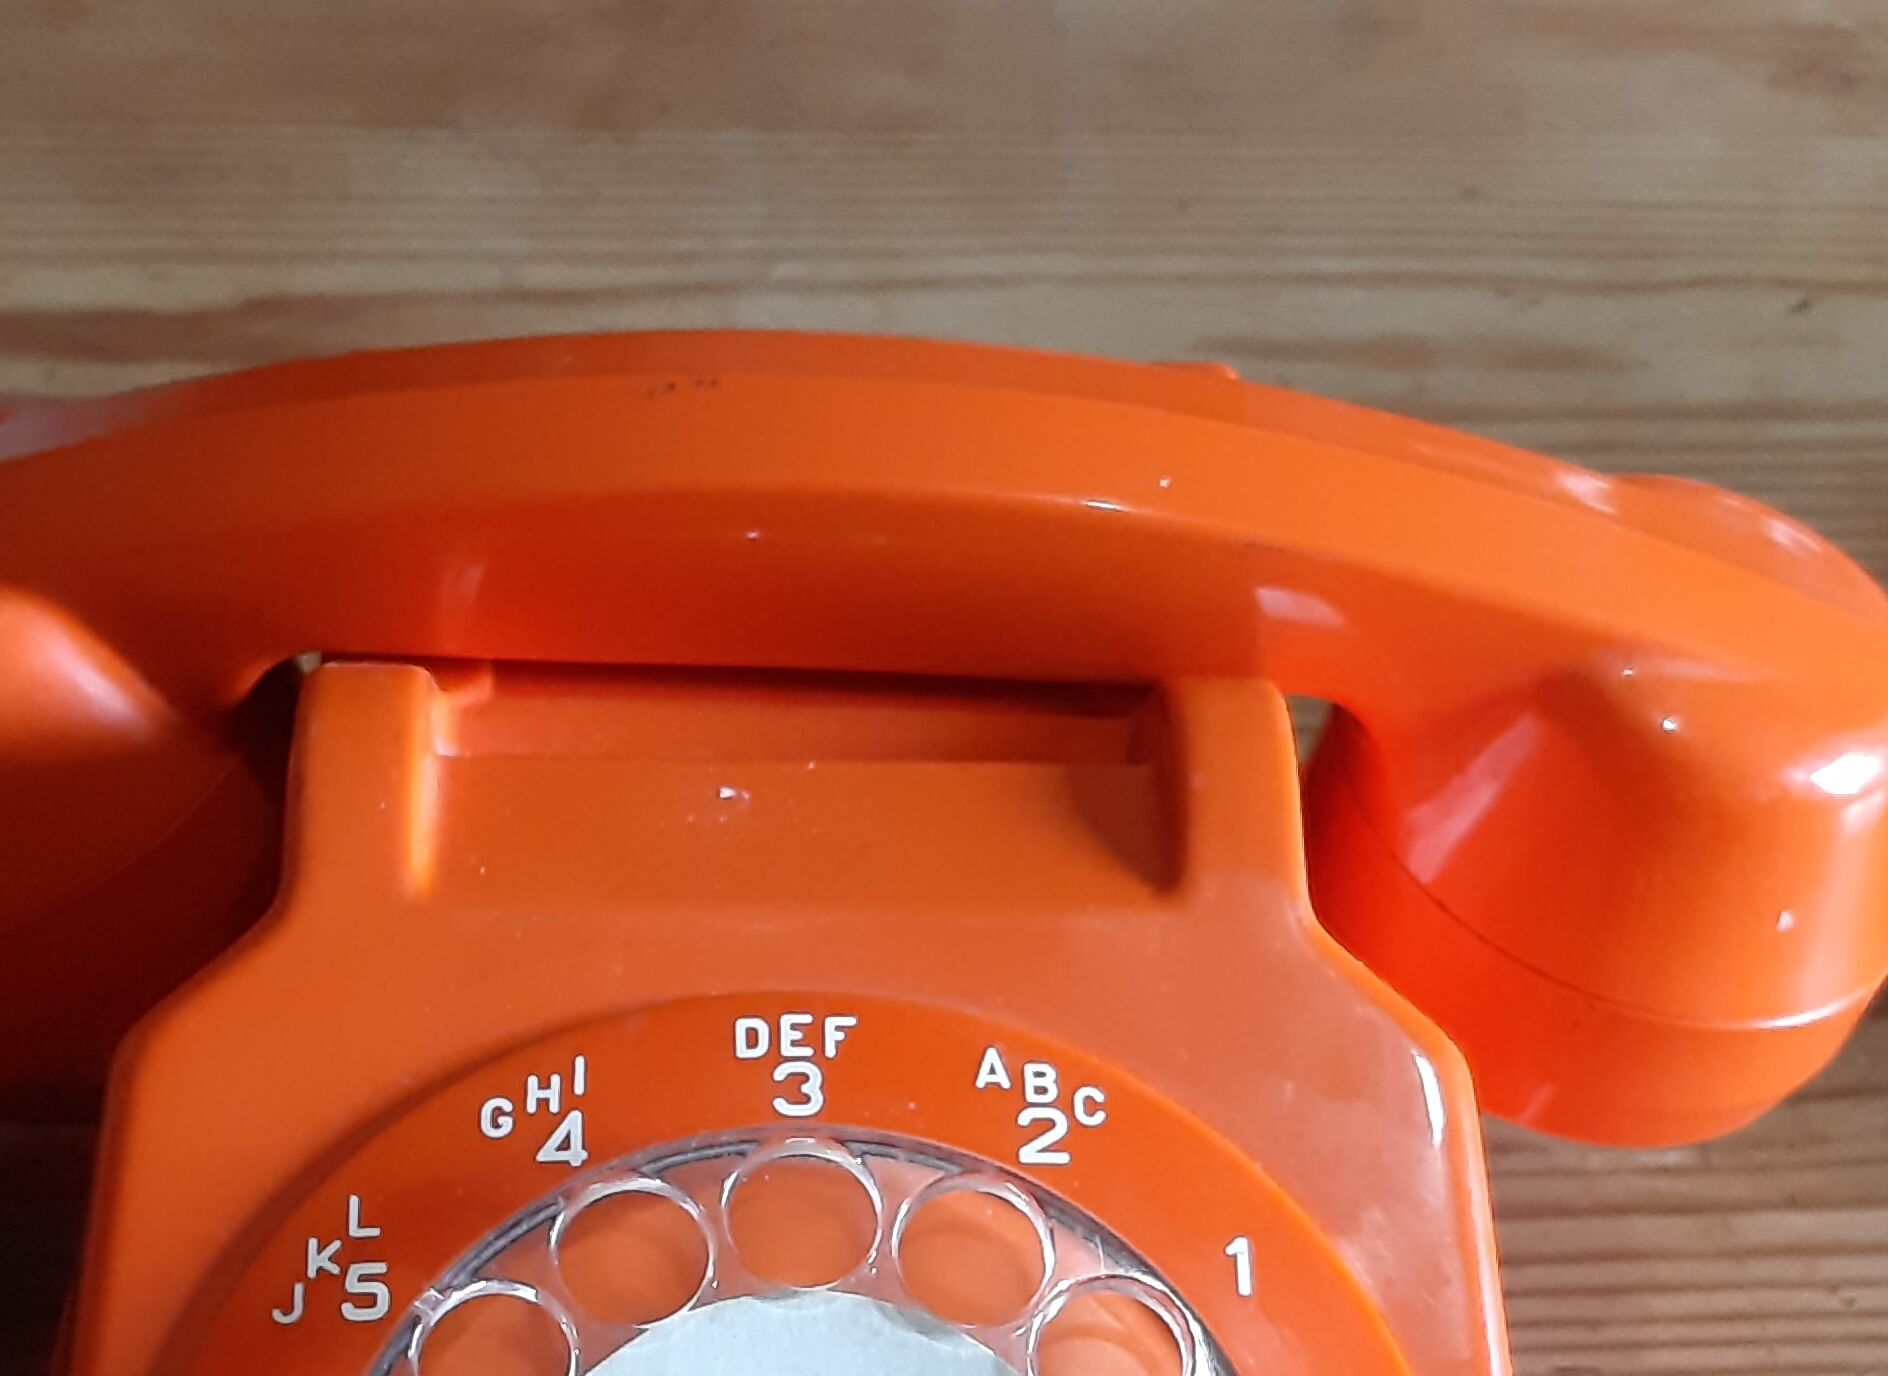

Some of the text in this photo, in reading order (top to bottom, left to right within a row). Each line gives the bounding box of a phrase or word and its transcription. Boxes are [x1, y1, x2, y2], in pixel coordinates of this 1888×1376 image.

[733, 1013, 859, 1059] DEF
[480, 1055, 586, 1139] GHI
[772, 1060, 825, 1117] 3
[975, 1045, 1108, 1127] ABC
[535, 1109, 589, 1167] 4
[1016, 1105, 1072, 1165] 2
[340, 1262, 391, 1322] 5
[1224, 1236, 1257, 1298] 1
